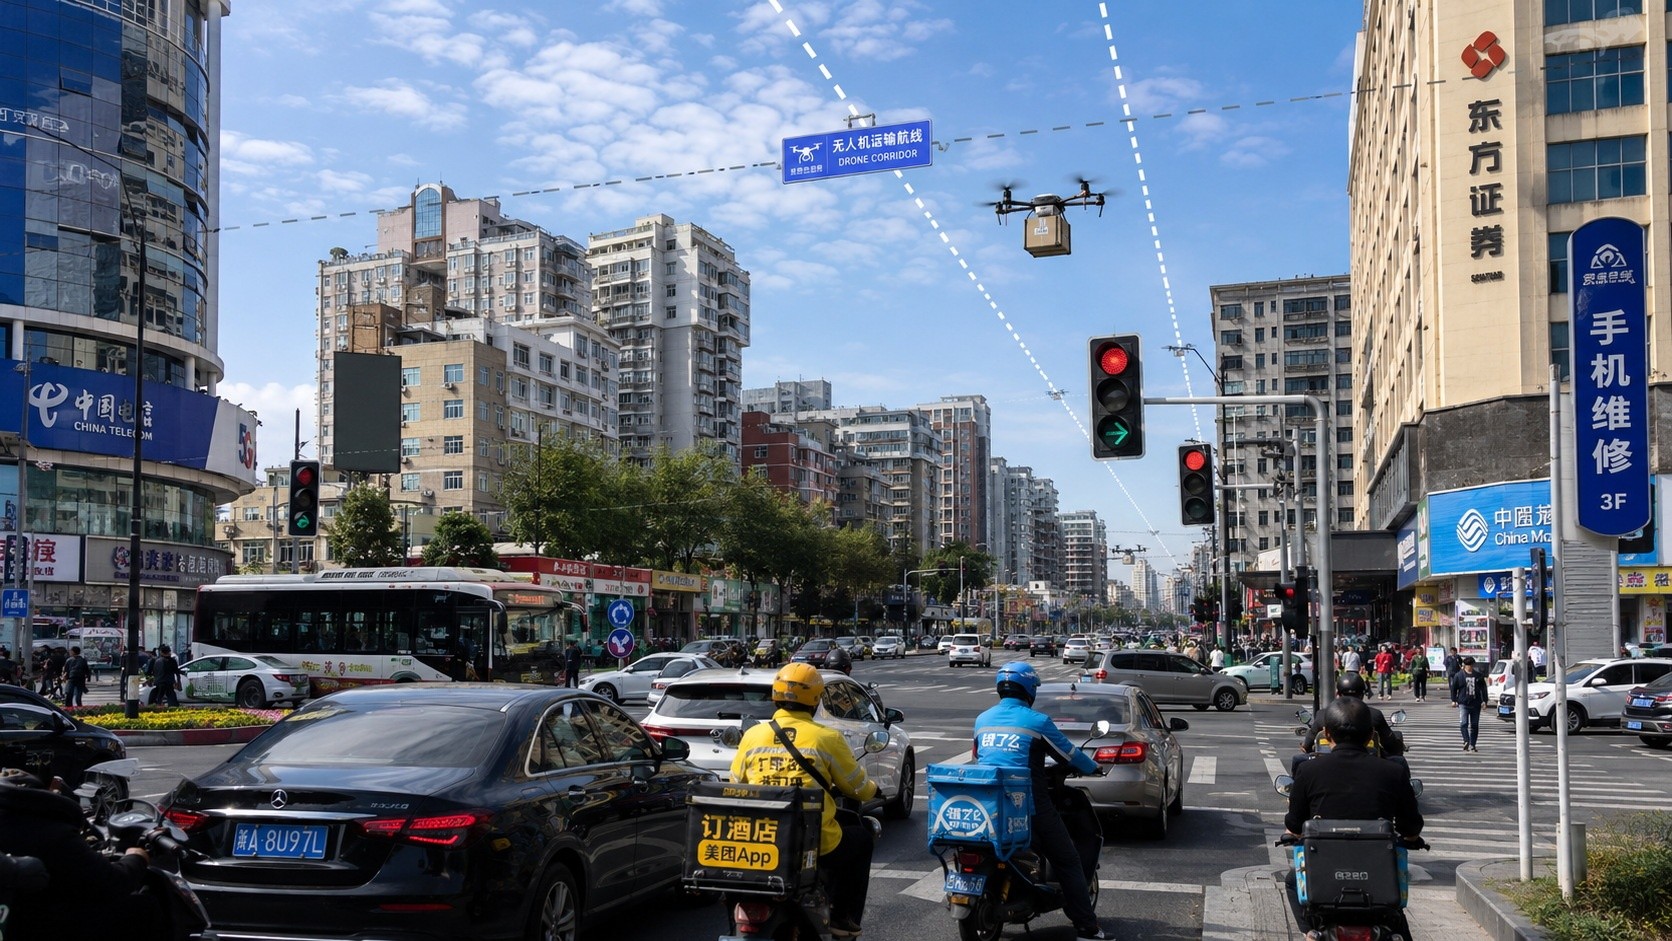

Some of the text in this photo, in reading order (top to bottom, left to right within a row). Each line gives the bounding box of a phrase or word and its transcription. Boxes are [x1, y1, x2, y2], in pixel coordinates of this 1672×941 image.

[832, 128, 923, 153] 无人机运输航线
[838, 148, 918, 167] DRONE CORRIDOR
[1590, 309, 1633, 474] 手机维修
[74, 421, 107, 434] CHINA
[239, 423, 254, 470] 5G
[1599, 493, 1628, 511] 3F
[1494, 531, 1529, 546] China
[701, 813, 779, 844] 订酒店
[704, 844, 772, 867] 美团App
